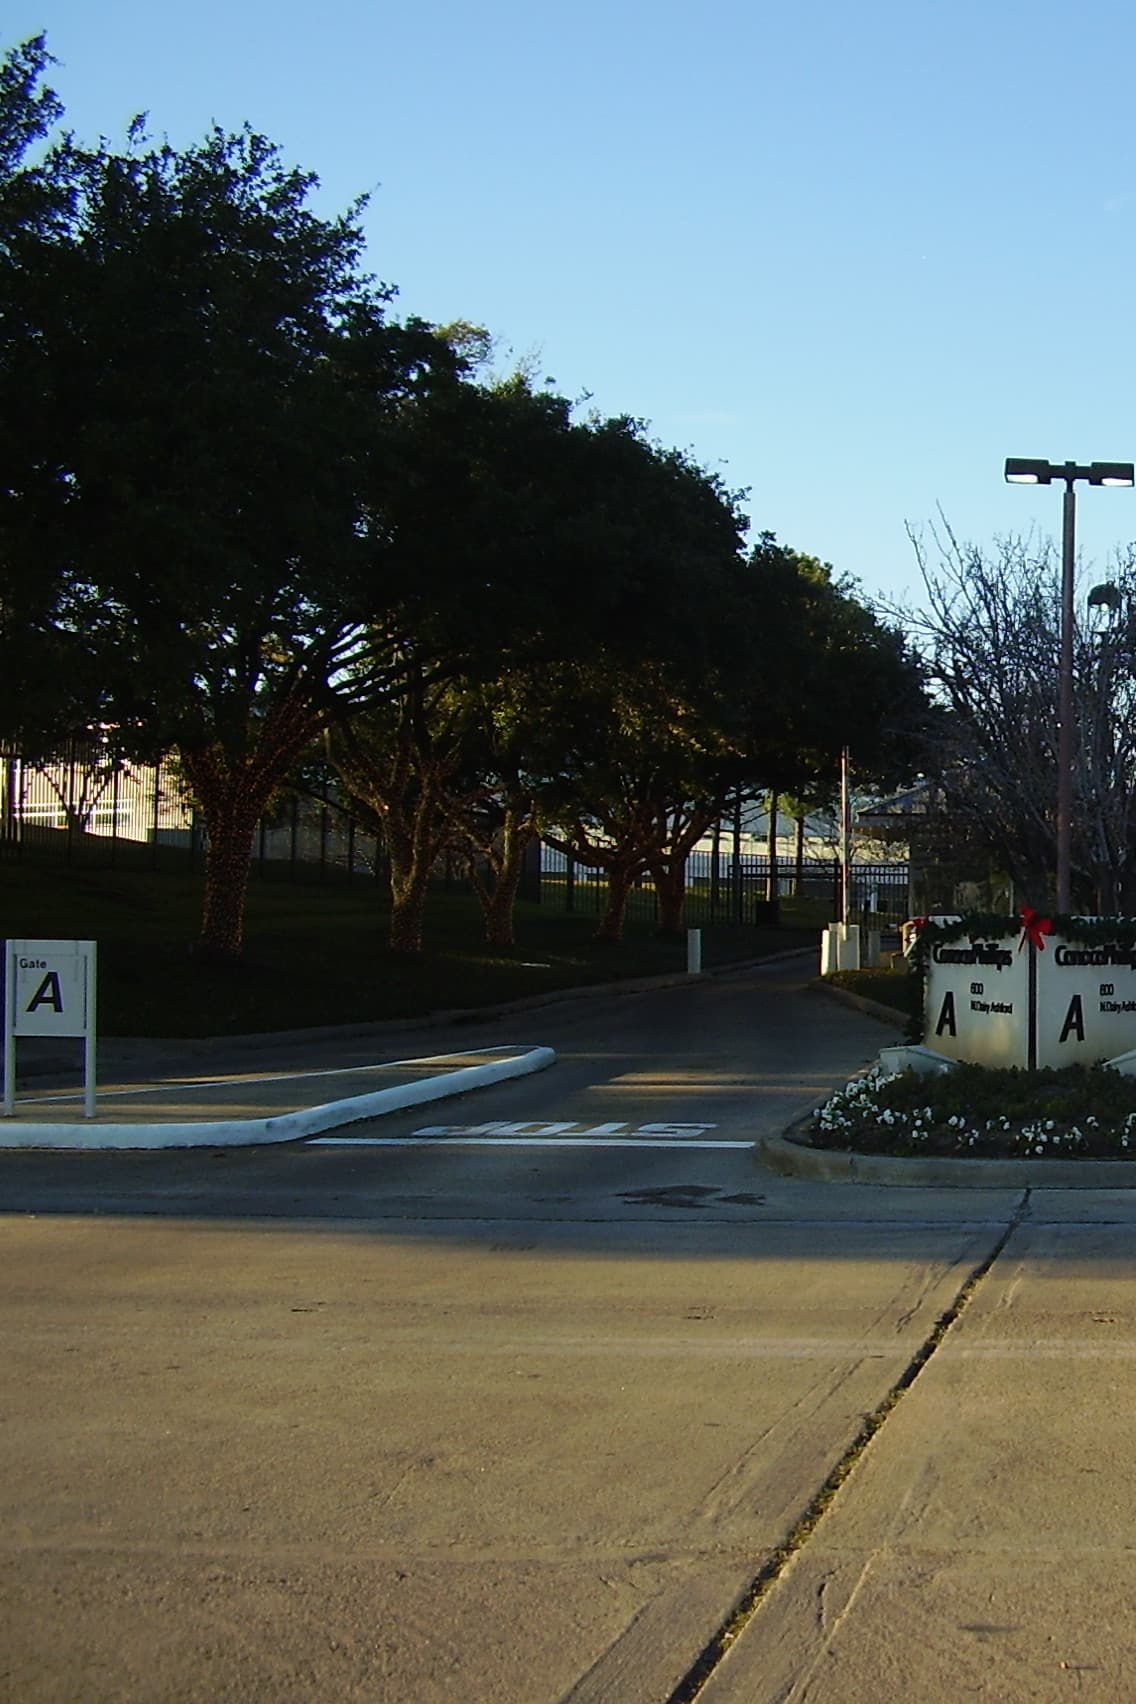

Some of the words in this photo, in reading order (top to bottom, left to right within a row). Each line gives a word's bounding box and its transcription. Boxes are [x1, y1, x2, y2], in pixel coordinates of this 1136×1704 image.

[19, 958, 47, 969] Gate
[26, 971, 63, 1013] A
[935, 991, 957, 1037] A
[1059, 994, 1085, 1043] A
